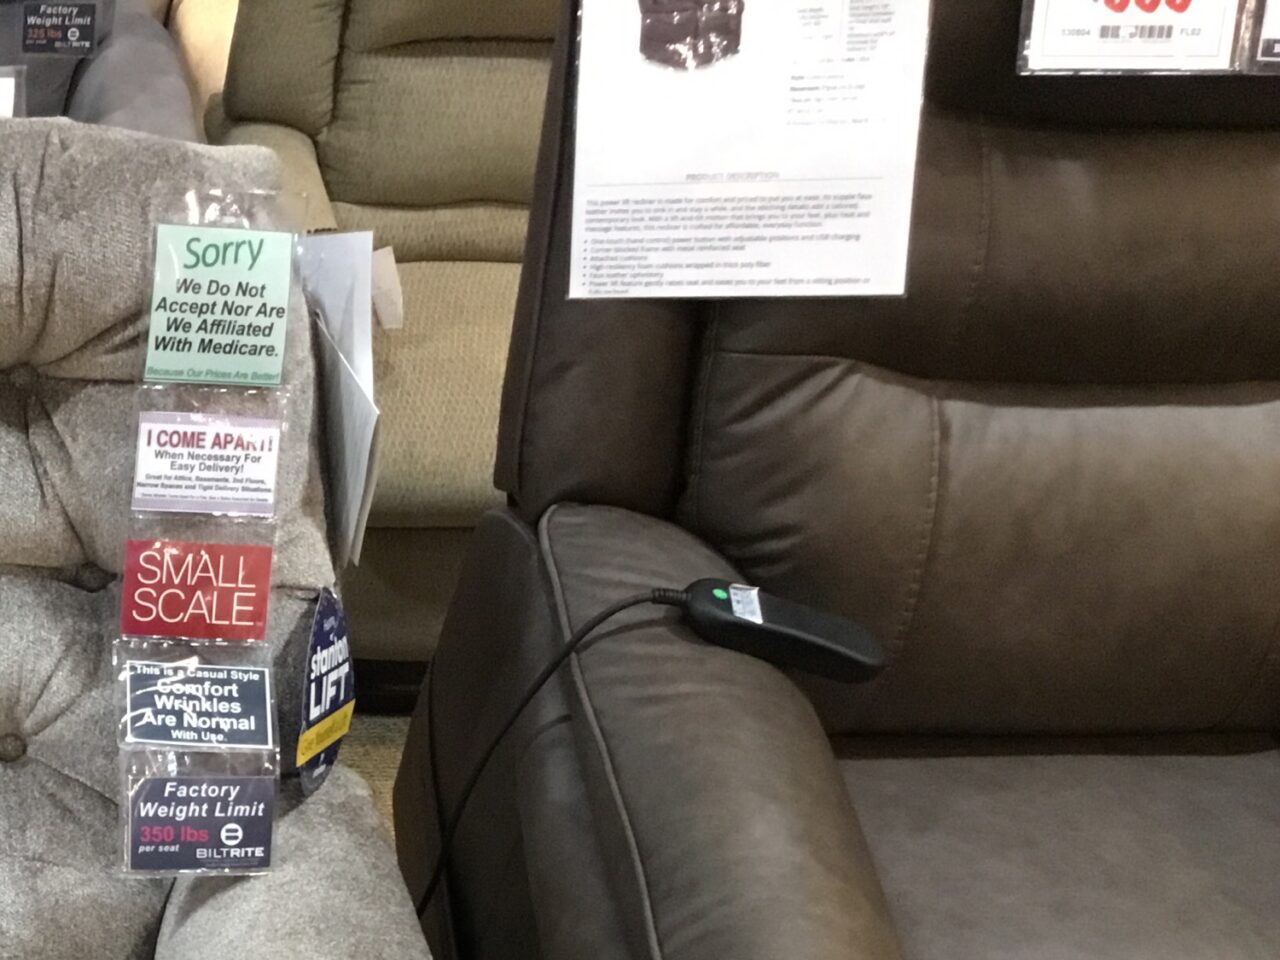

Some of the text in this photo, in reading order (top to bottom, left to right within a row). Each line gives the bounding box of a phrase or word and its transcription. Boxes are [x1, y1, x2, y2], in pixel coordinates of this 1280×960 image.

[40, 5, 78, 16] Factory
[27, 16, 62, 27] Weight
[183, 237, 264, 271] Sorry
[176, 278, 266, 298] We Do Not
[155, 297, 286, 318] Accept Nor Are
[166, 317, 274, 337] We Affiliated
[154, 336, 279, 357] With Medicare.
[147, 429, 152, 447] I
[157, 430, 206, 449] COME
[154, 449, 262, 464] When Necessary For
[170, 461, 244, 475] Easy Delivery!
[137, 551, 256, 588] SMALL
[132, 587, 256, 626] SCALE
[136, 665, 160, 675] This
[163, 667, 174, 676] is
[187, 669, 227, 679] Casual
[230, 670, 260, 682] Style
[157, 679, 239, 697] Comfort
[309, 662, 349, 721] LIFT
[154, 695, 242, 714] Wrinkles
[143, 711, 256, 730] Are Normal
[171, 729, 198, 740] With
[164, 782, 241, 801] Factory
[139, 802, 265, 821] Weight Limit
[140, 826, 209, 842] 350 lbs
[138, 844, 265, 859] per seat BILTRITE
